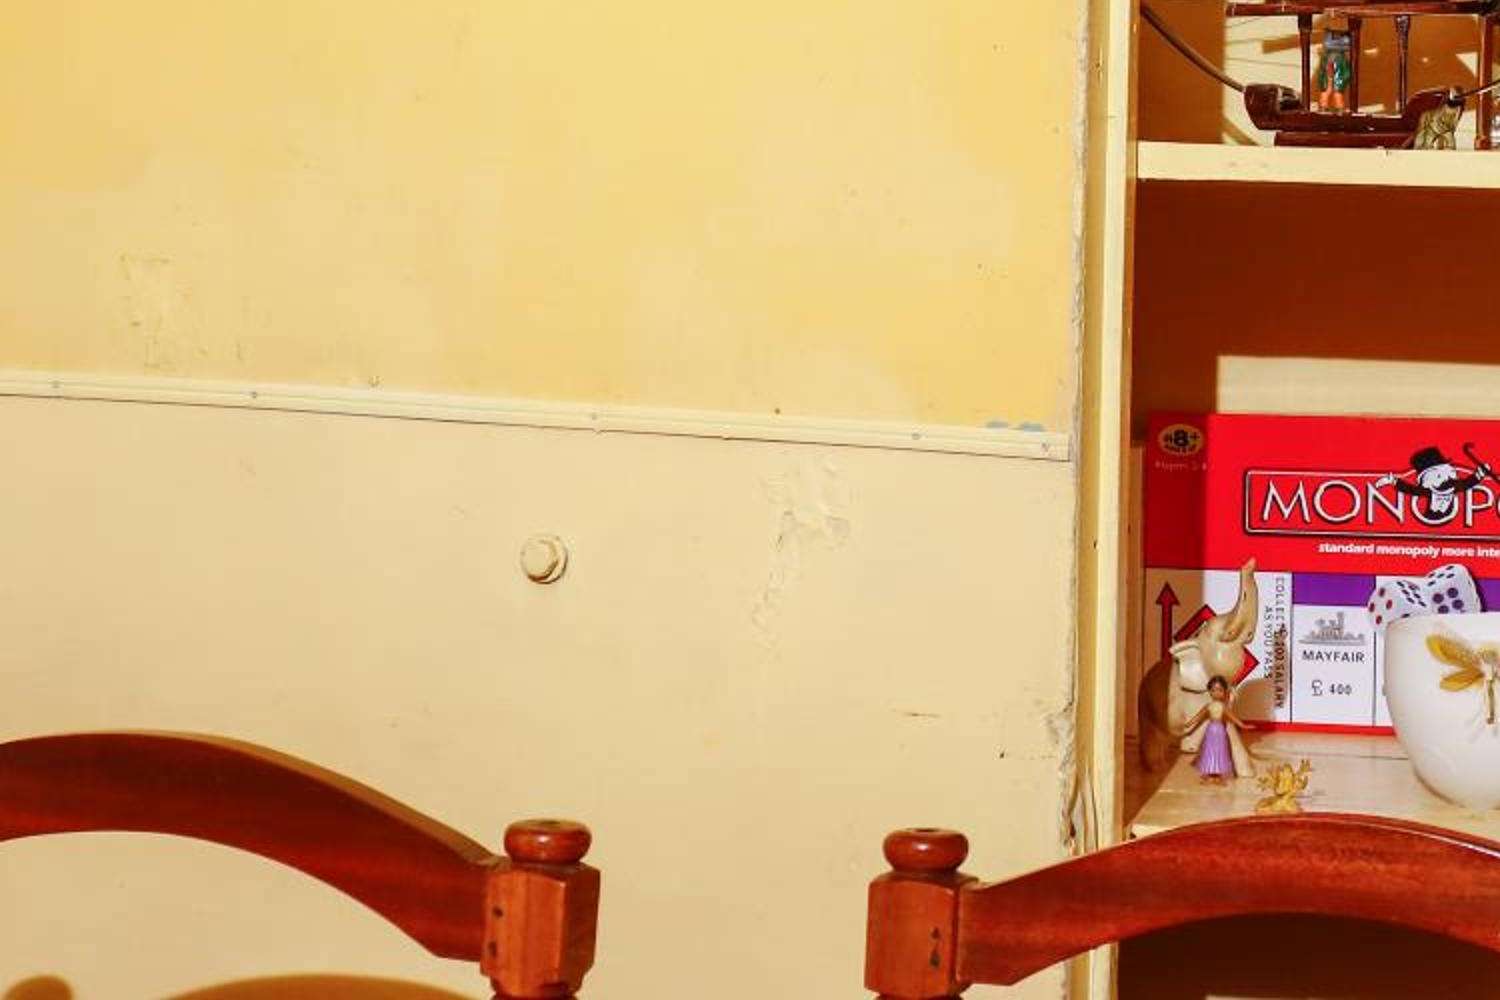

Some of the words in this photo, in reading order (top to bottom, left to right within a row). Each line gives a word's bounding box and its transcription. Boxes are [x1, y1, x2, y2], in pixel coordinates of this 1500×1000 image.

[1318, 541, 1375, 555] standard
[1376, 545, 1441, 559] monopoly
[1442, 547, 1475, 557] more
[1264, 605, 1273, 623] AS
[1264, 624, 1273, 647] YOU
[1264, 648, 1273, 680] PASS
[1301, 649, 1366, 664] MAYFAIR
[1274, 663, 1285, 709] SALARY
[1311, 679, 1324, 697] £
[1328, 683, 1353, 696] 400
